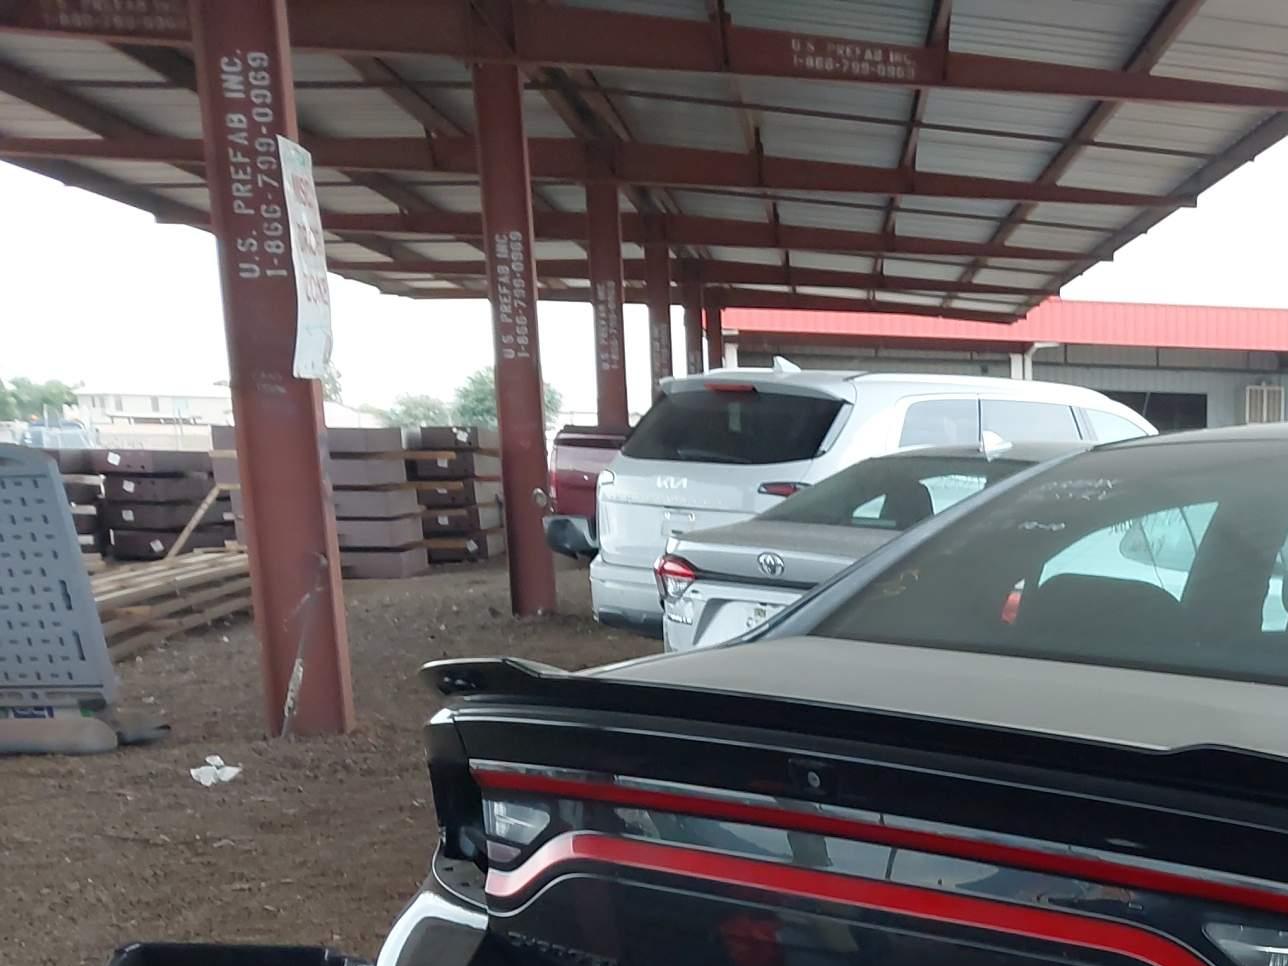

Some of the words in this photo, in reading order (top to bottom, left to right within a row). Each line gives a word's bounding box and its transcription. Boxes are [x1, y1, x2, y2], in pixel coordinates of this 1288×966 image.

[219, 49, 246, 98] INC.
[225, 112, 255, 215] PREFAB
[246, 51, 288, 277] 1-866-799-0969
[237, 228, 260, 279] U.S.
[496, 264, 513, 323] PREFAB
[656, 475, 688, 489] KIA
